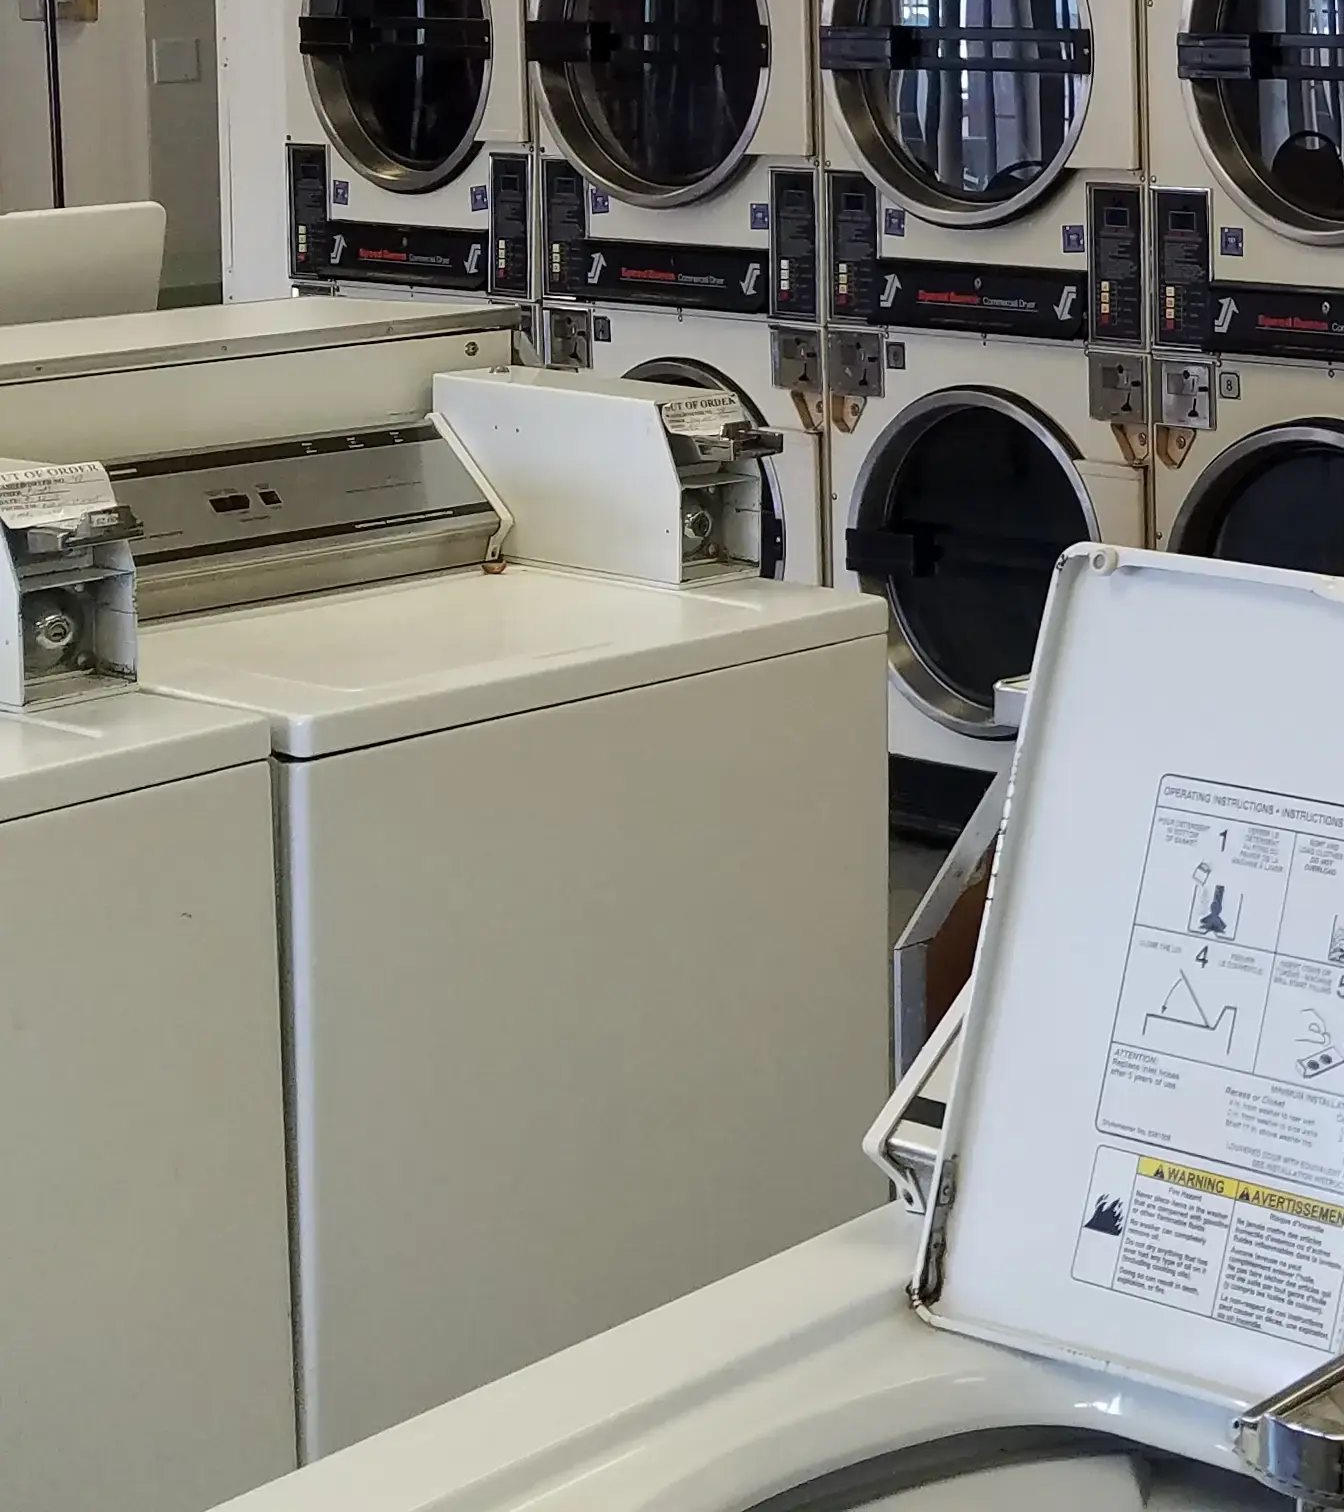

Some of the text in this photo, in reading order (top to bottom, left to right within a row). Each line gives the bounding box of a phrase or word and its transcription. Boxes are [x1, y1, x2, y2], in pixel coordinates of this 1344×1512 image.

[1226, 379, 1233, 392] 8
[685, 401, 698, 410] OF
[700, 398, 736, 408] ORDER
[1219, 829, 1228, 852] 1
[1196, 946, 1209, 968] 4
[1168, 1168, 1225, 1194] WARNING
